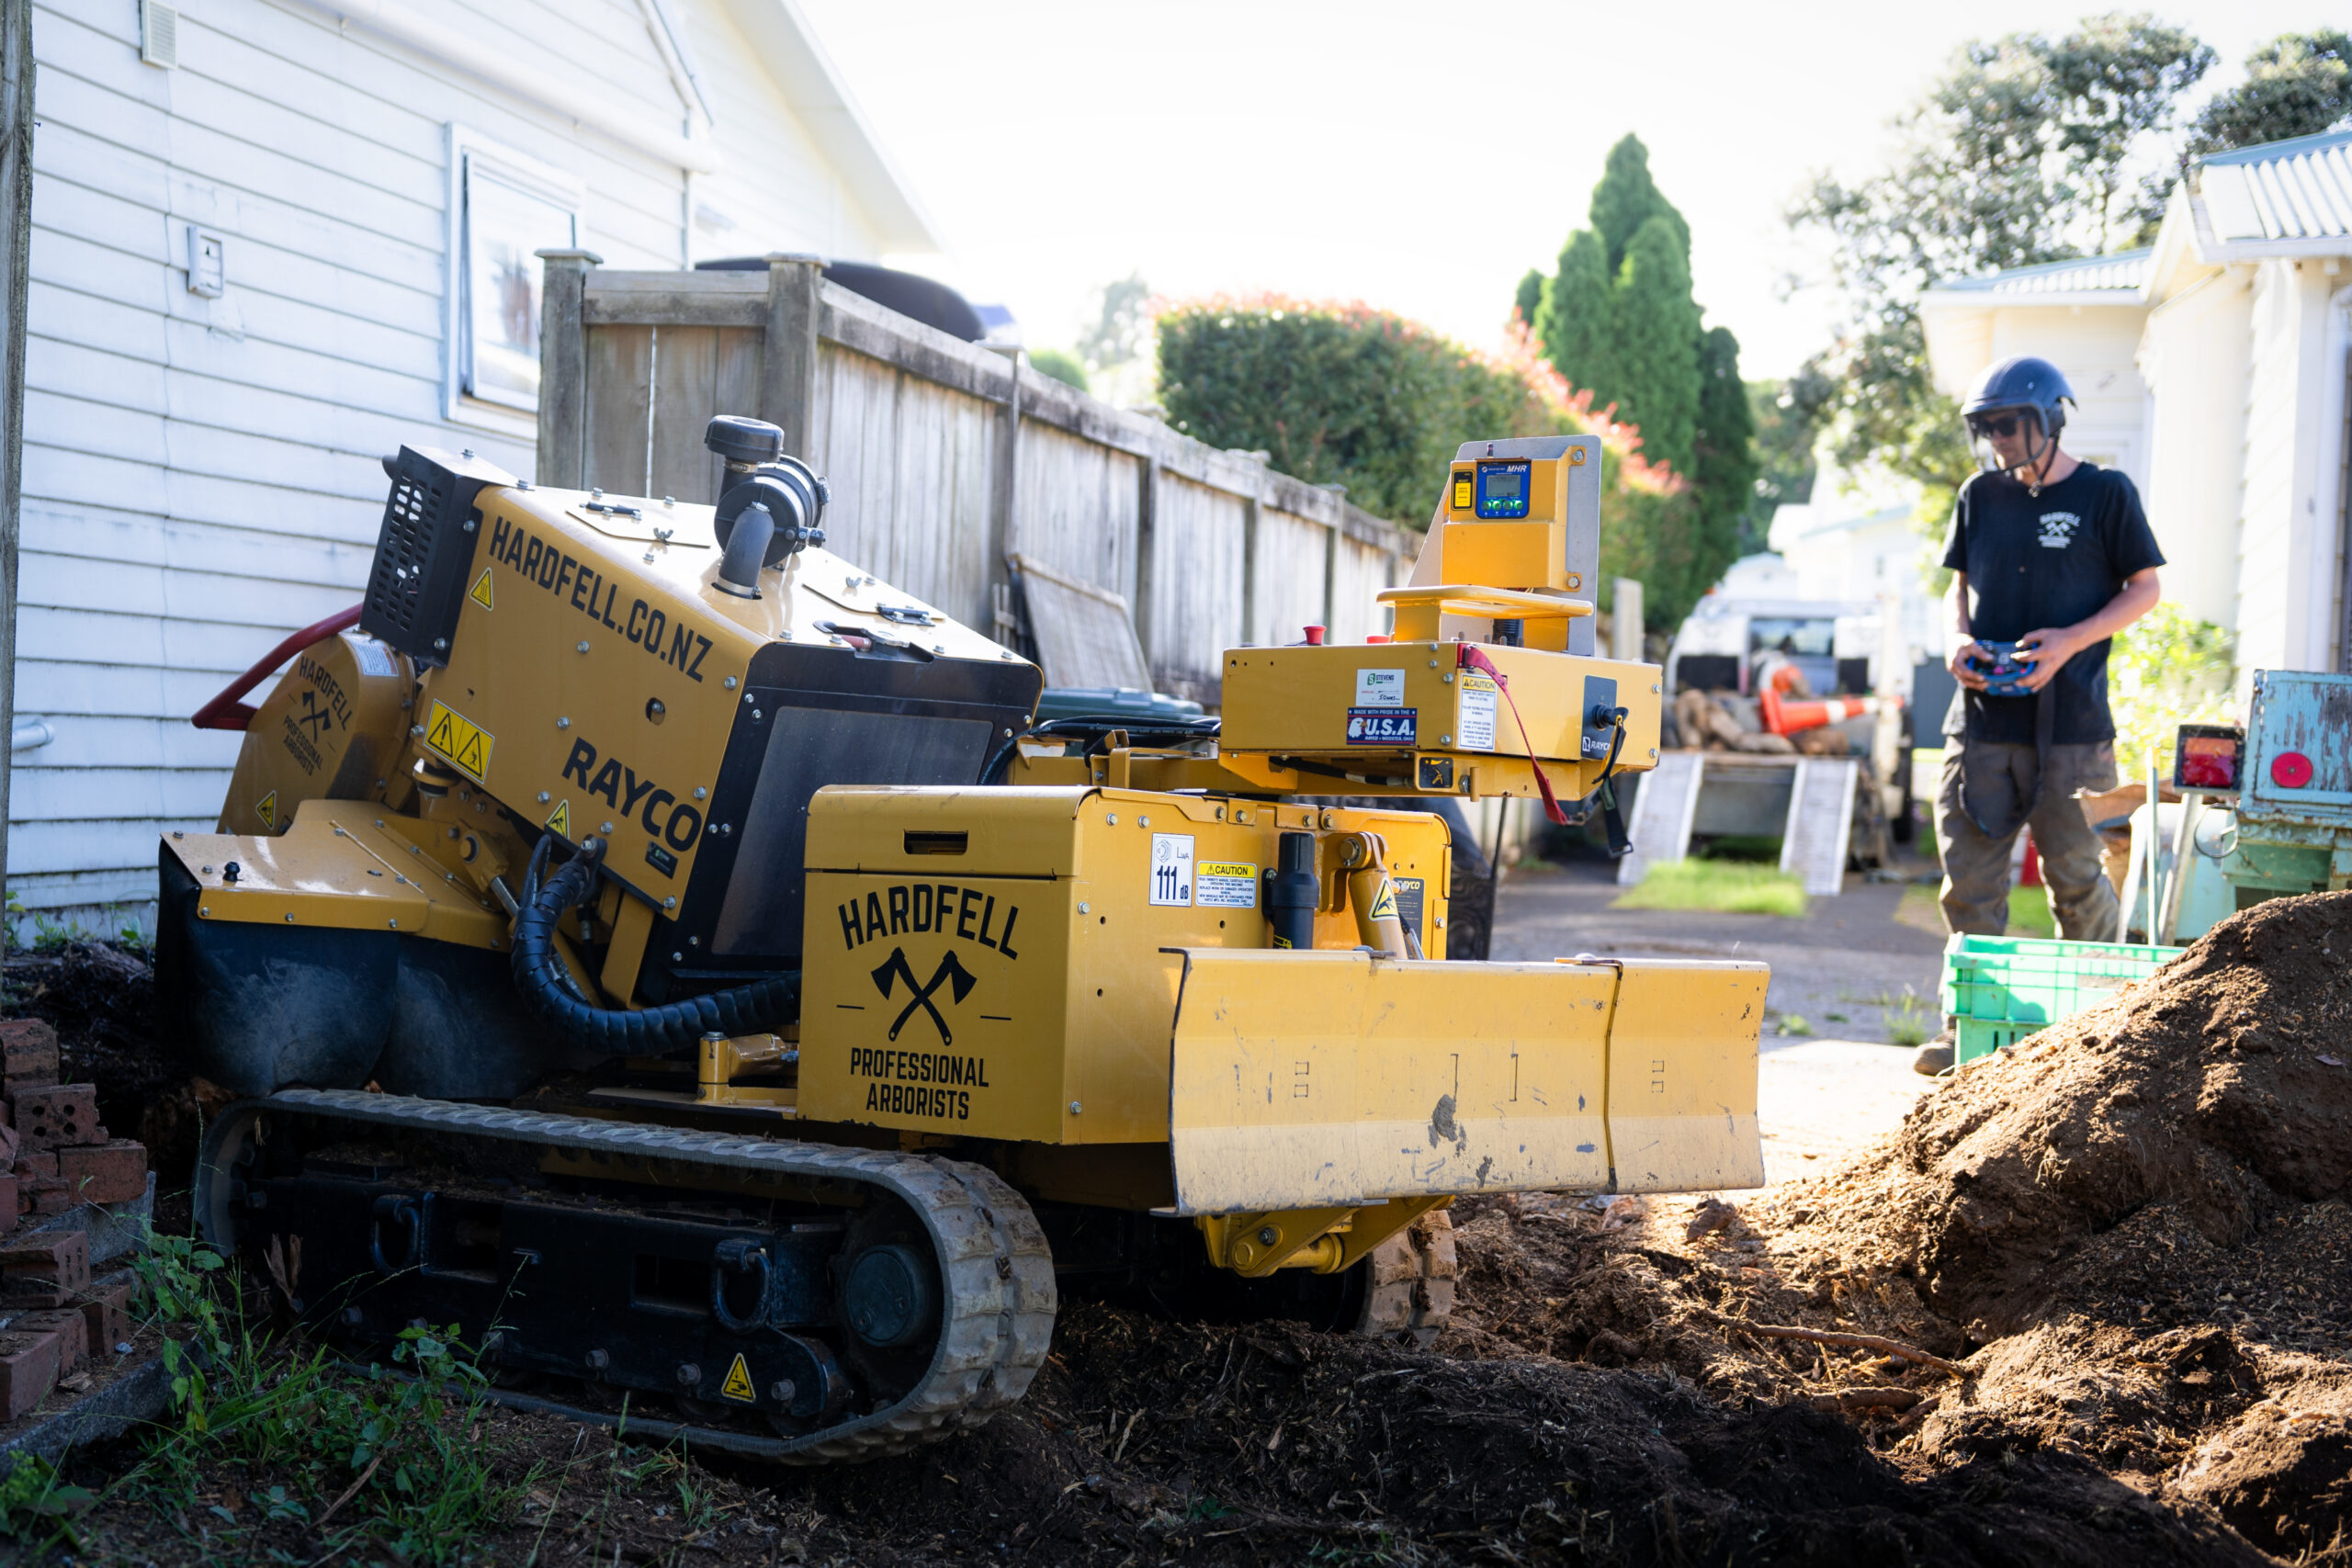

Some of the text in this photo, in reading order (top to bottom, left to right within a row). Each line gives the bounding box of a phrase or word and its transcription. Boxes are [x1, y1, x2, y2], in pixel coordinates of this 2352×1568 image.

[1507, 465, 1527, 473] MHR
[489, 516, 713, 683] HARDFELL.CO.NZ
[300, 656, 352, 731] HARDFELL
[1470, 679, 1495, 689] CAUTION
[283, 715, 323, 771] PROFESSIONAL
[1365, 718, 1415, 736] U.S.A.
[283, 733, 314, 777] ARBORISTS
[561, 737, 702, 852] RAYCO
[1157, 864, 1178, 900] 111
[1215, 865, 1249, 875] CAUTION
[1180, 885, 1189, 900] dB
[838, 884, 1019, 961] HARDFELL
[851, 1047, 989, 1088] PROFESSIONAL
[865, 1083, 970, 1121] ARBORISTS
